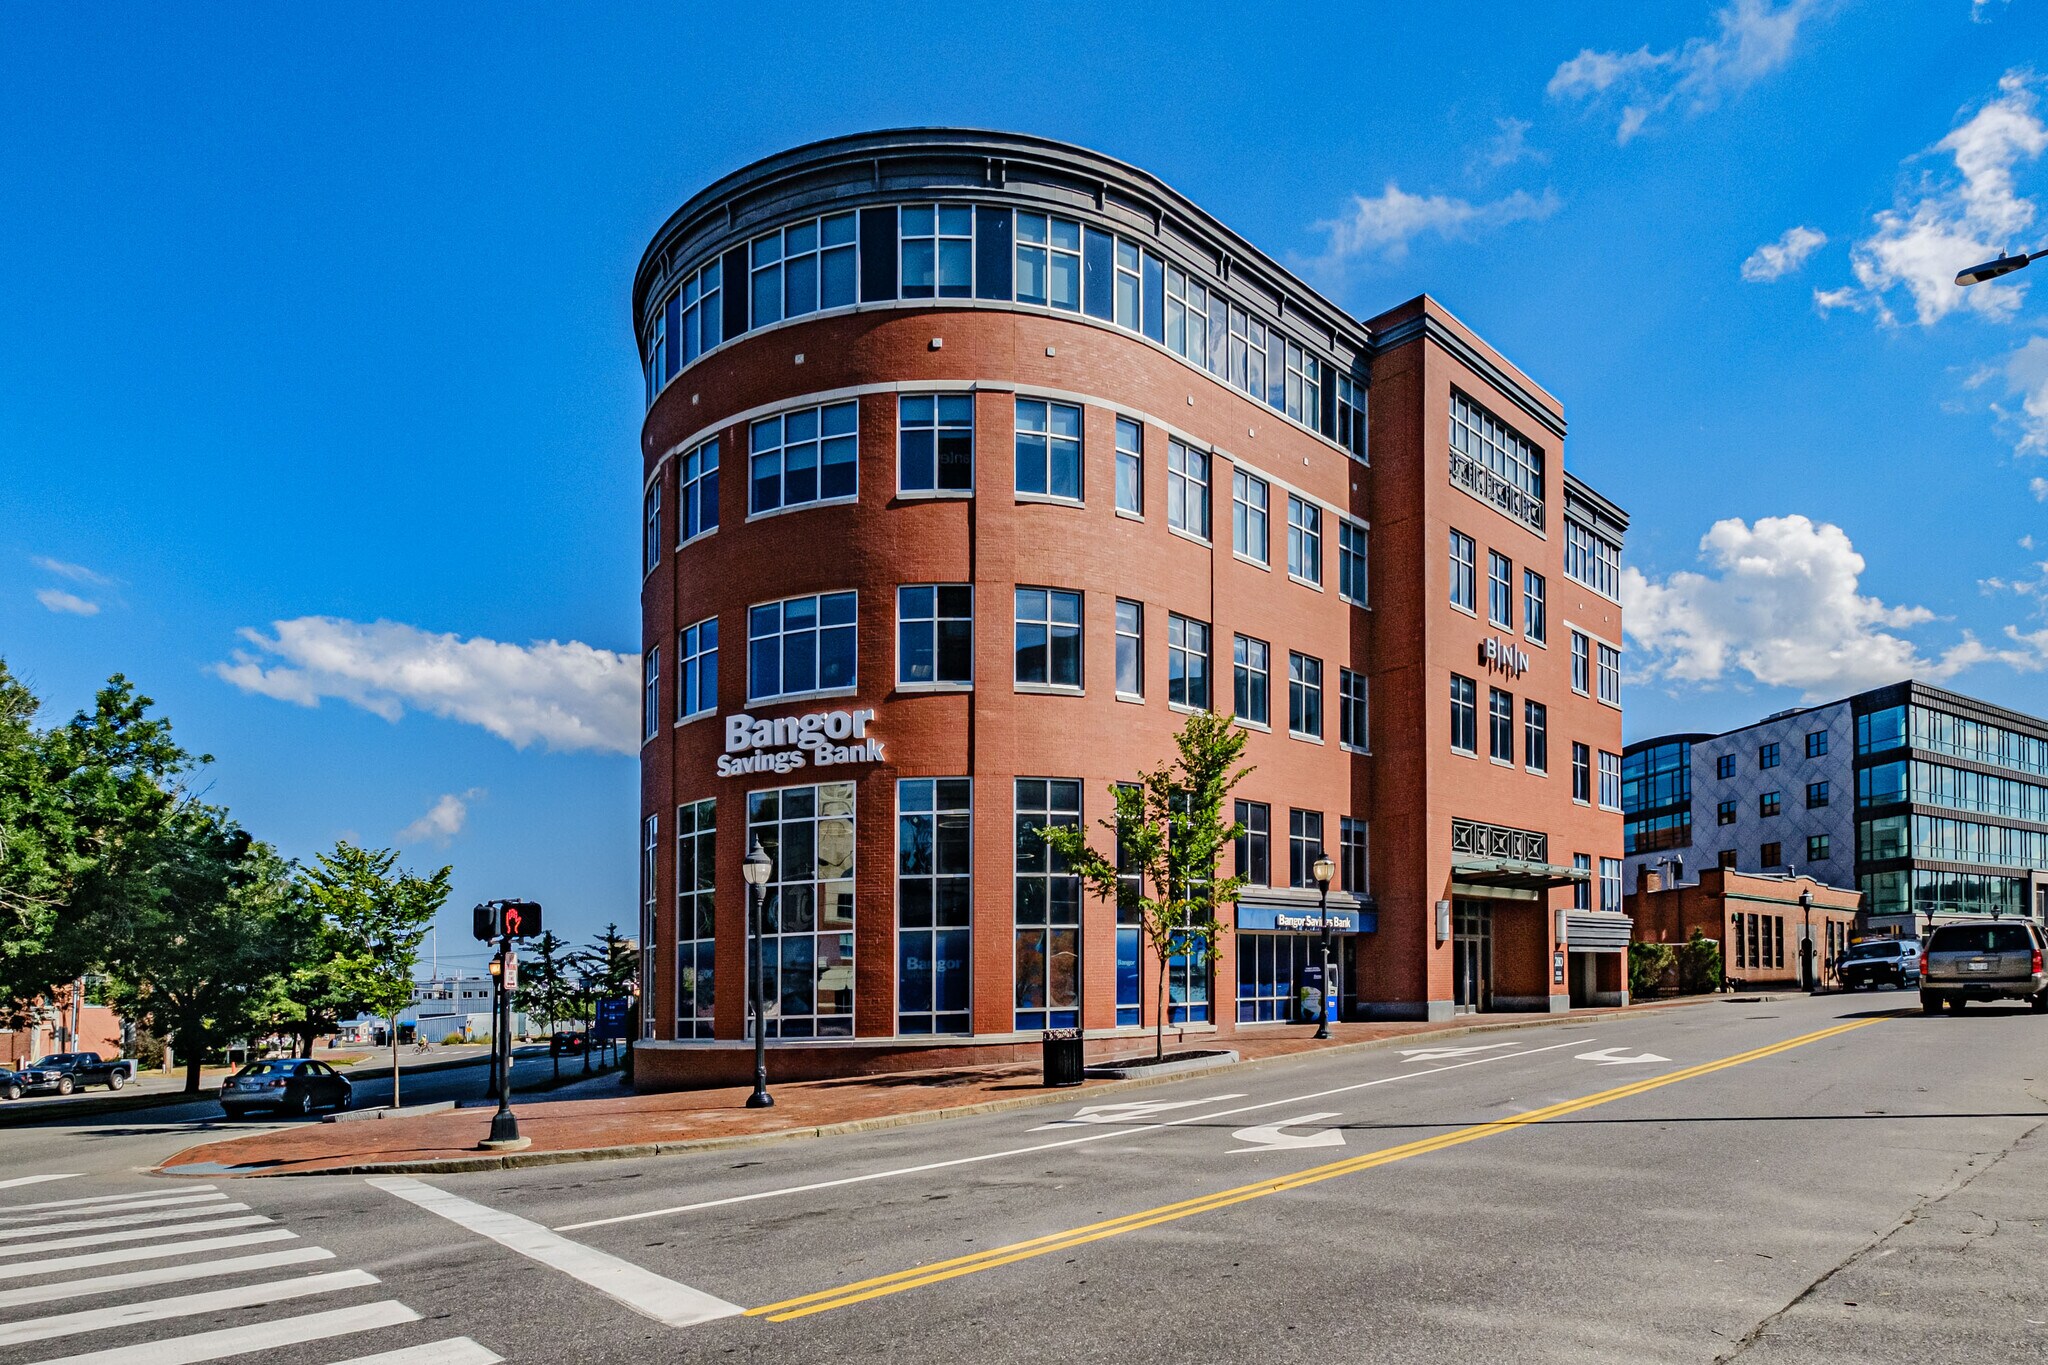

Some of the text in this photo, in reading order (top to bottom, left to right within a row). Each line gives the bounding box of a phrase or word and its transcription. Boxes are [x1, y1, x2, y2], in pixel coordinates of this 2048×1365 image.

[725, 708, 874, 753] Bangor
[716, 738, 886, 777] Savings Bank
[1278, 913, 1305, 928] Bangor
[1333, 916, 1351, 928] Bank
[1117, 959, 1136, 967] Bangor
